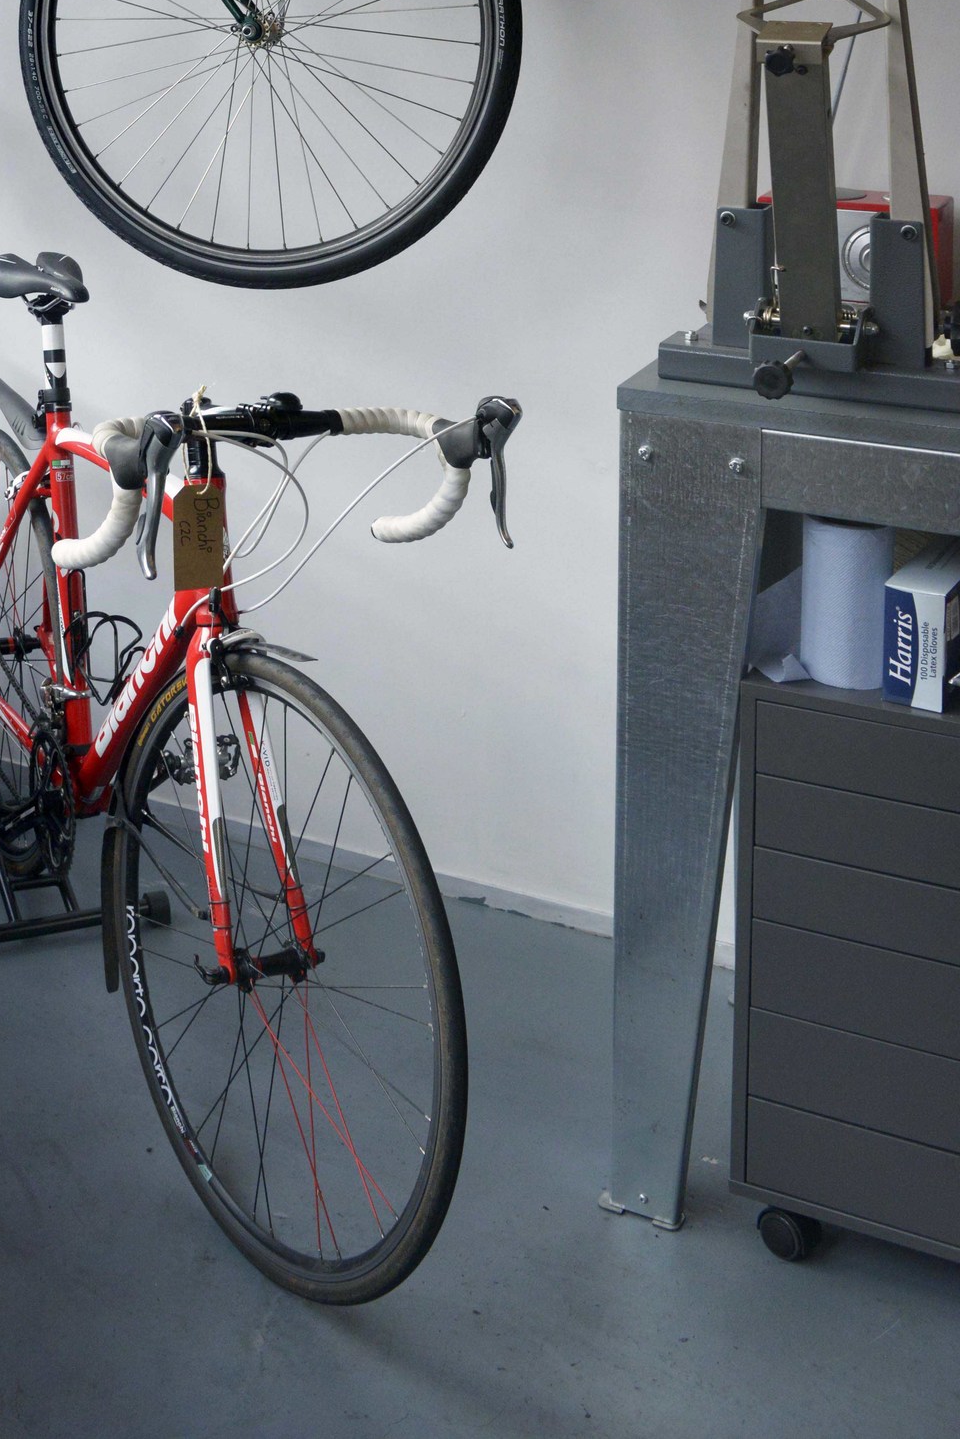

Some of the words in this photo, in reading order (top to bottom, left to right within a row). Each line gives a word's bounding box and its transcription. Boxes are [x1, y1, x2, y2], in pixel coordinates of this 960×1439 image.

[193, 497, 220, 554] Bianchi
[889, 610, 913, 687] Harris
[920, 621, 930, 669] Disposable
[929, 626, 938, 654] Gloves
[929, 655, 937, 679] Latex
[90, 593, 180, 759] Bianchi
[920, 670, 929, 681] 100
[187, 703, 210, 853] Bianchi
[257, 771, 278, 843] Bianchi
